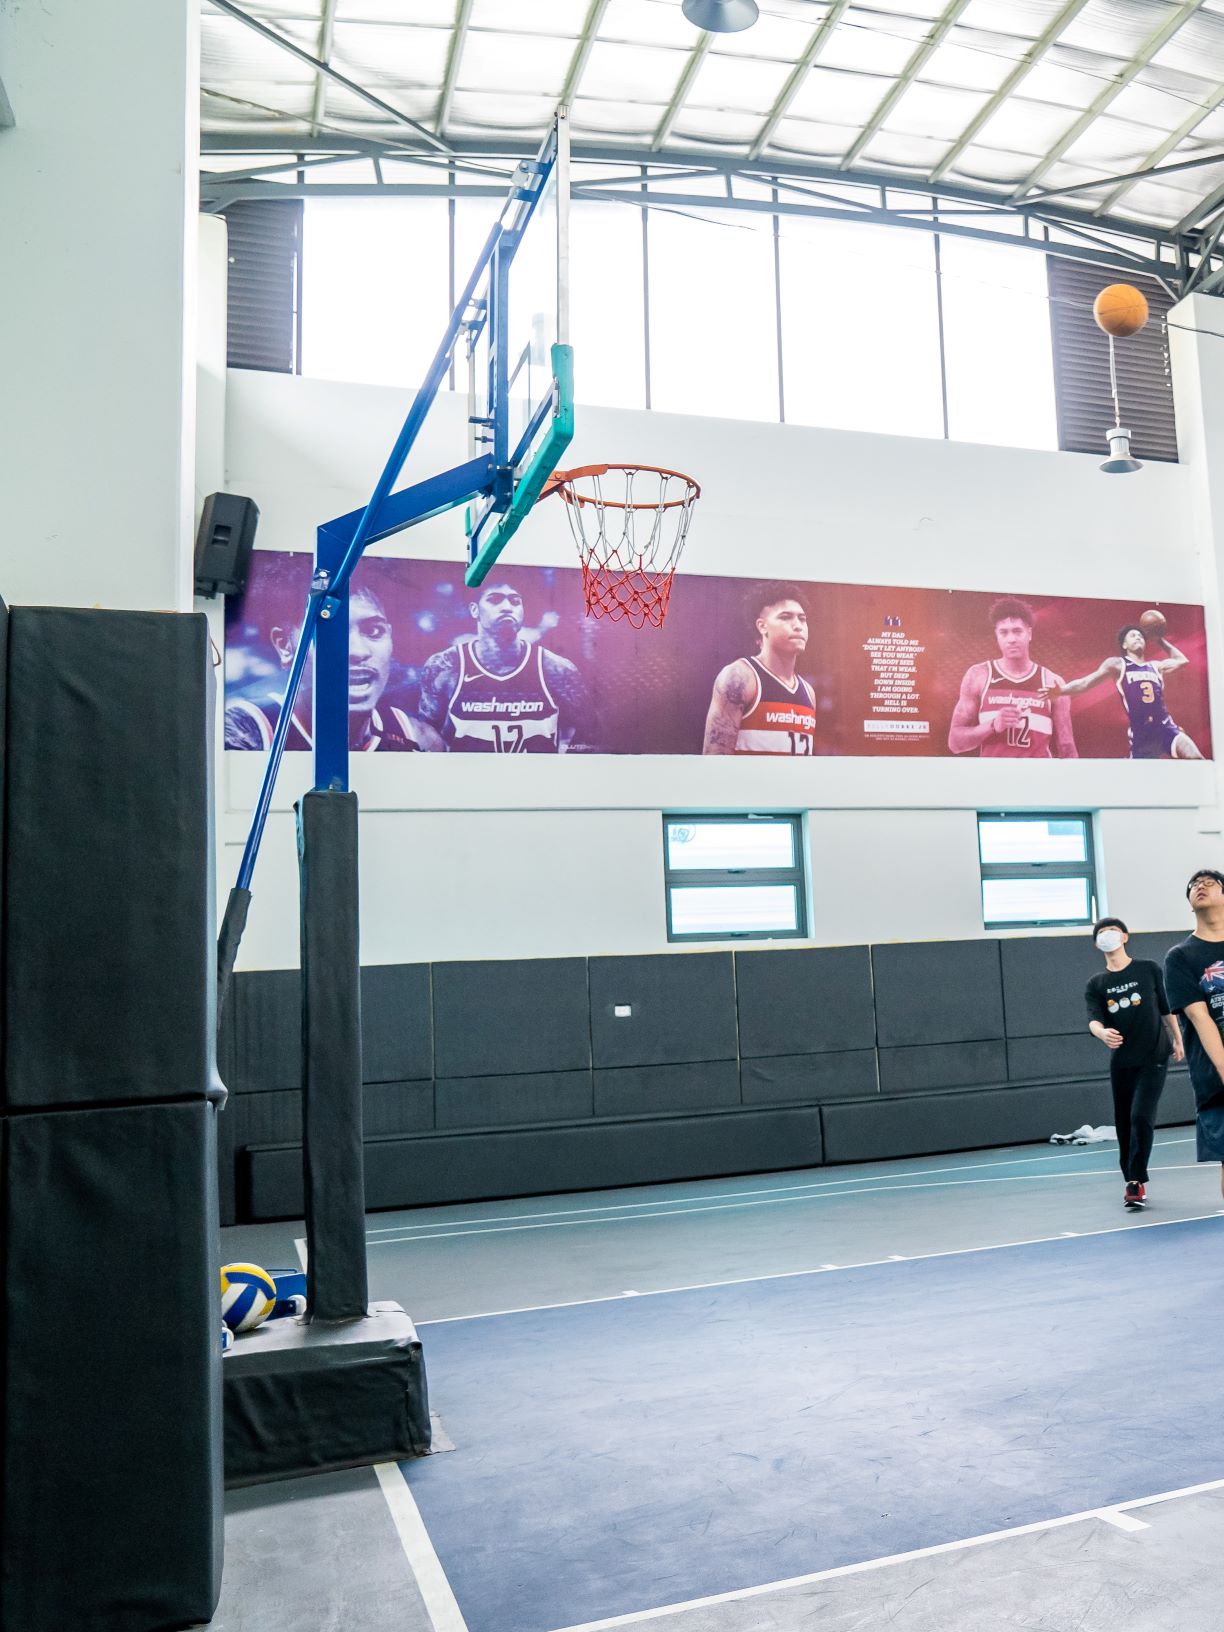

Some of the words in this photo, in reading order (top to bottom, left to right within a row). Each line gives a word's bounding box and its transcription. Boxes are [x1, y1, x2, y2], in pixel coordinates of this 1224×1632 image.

[988, 693, 1045, 709] washington
[1140, 681, 1155, 703] 3
[461, 697, 544, 716] washington
